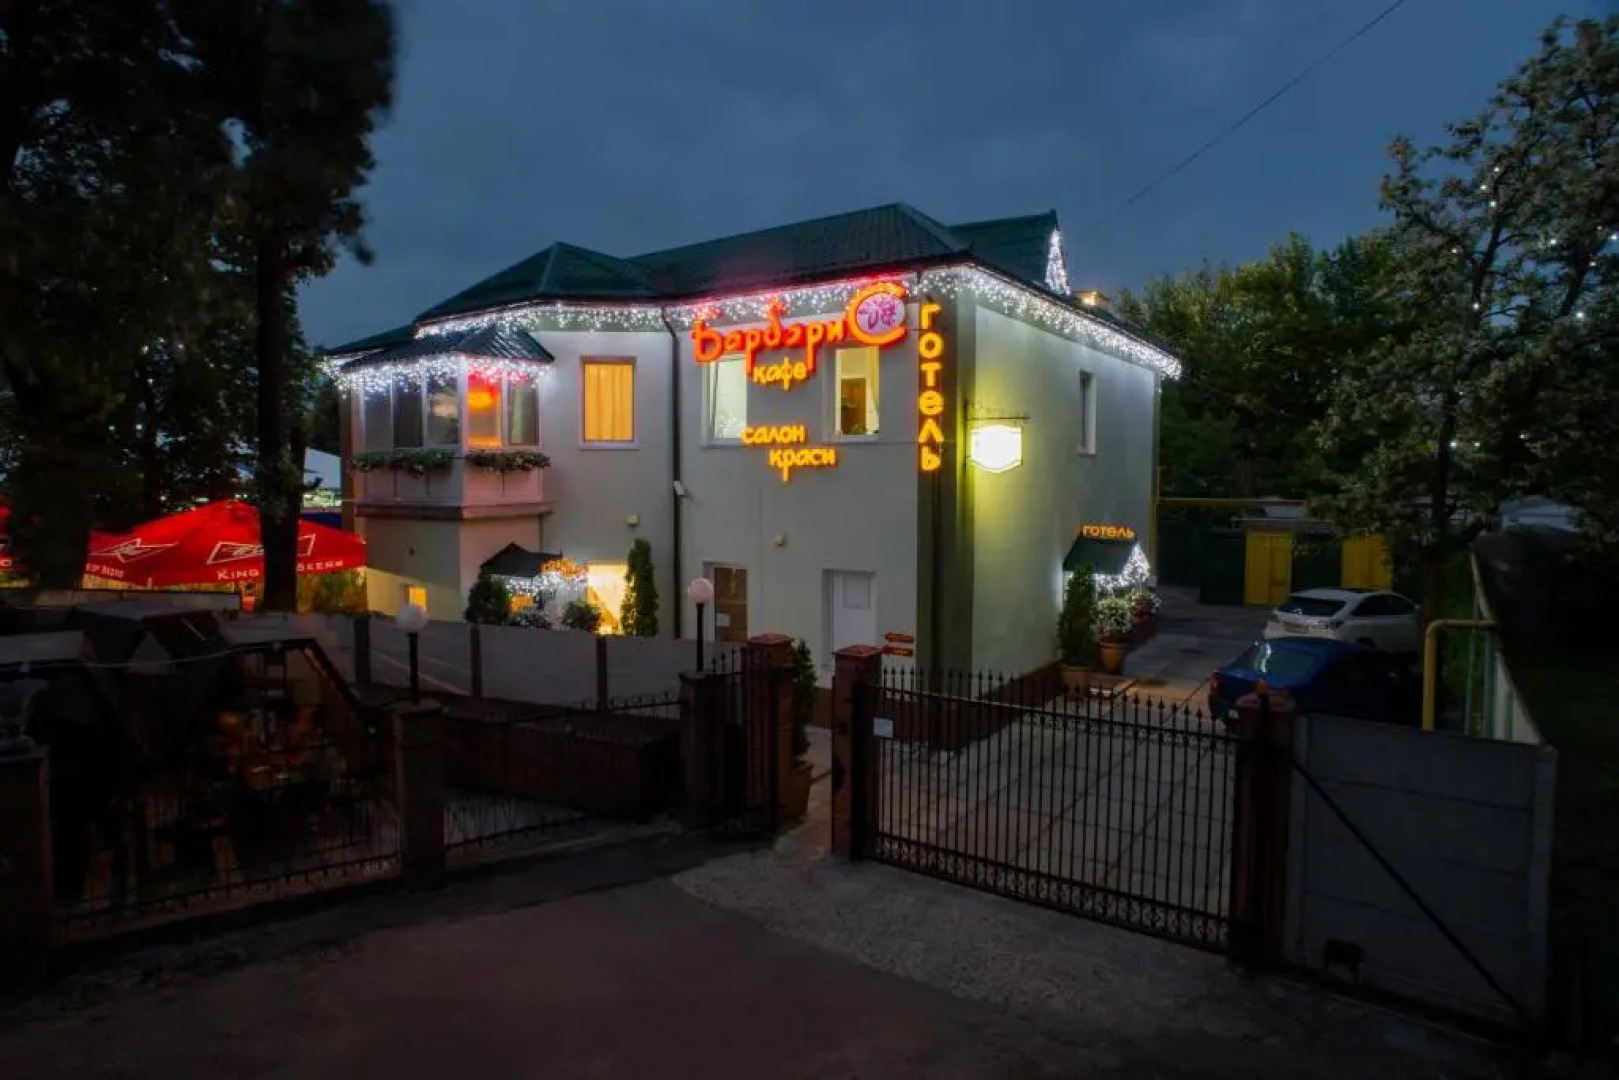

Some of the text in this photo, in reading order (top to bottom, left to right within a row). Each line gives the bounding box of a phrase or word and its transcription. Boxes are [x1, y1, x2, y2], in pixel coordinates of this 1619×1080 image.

[752, 356, 807, 391] кафе
[740, 424, 806, 444] салон
[769, 448, 836, 482] краси
